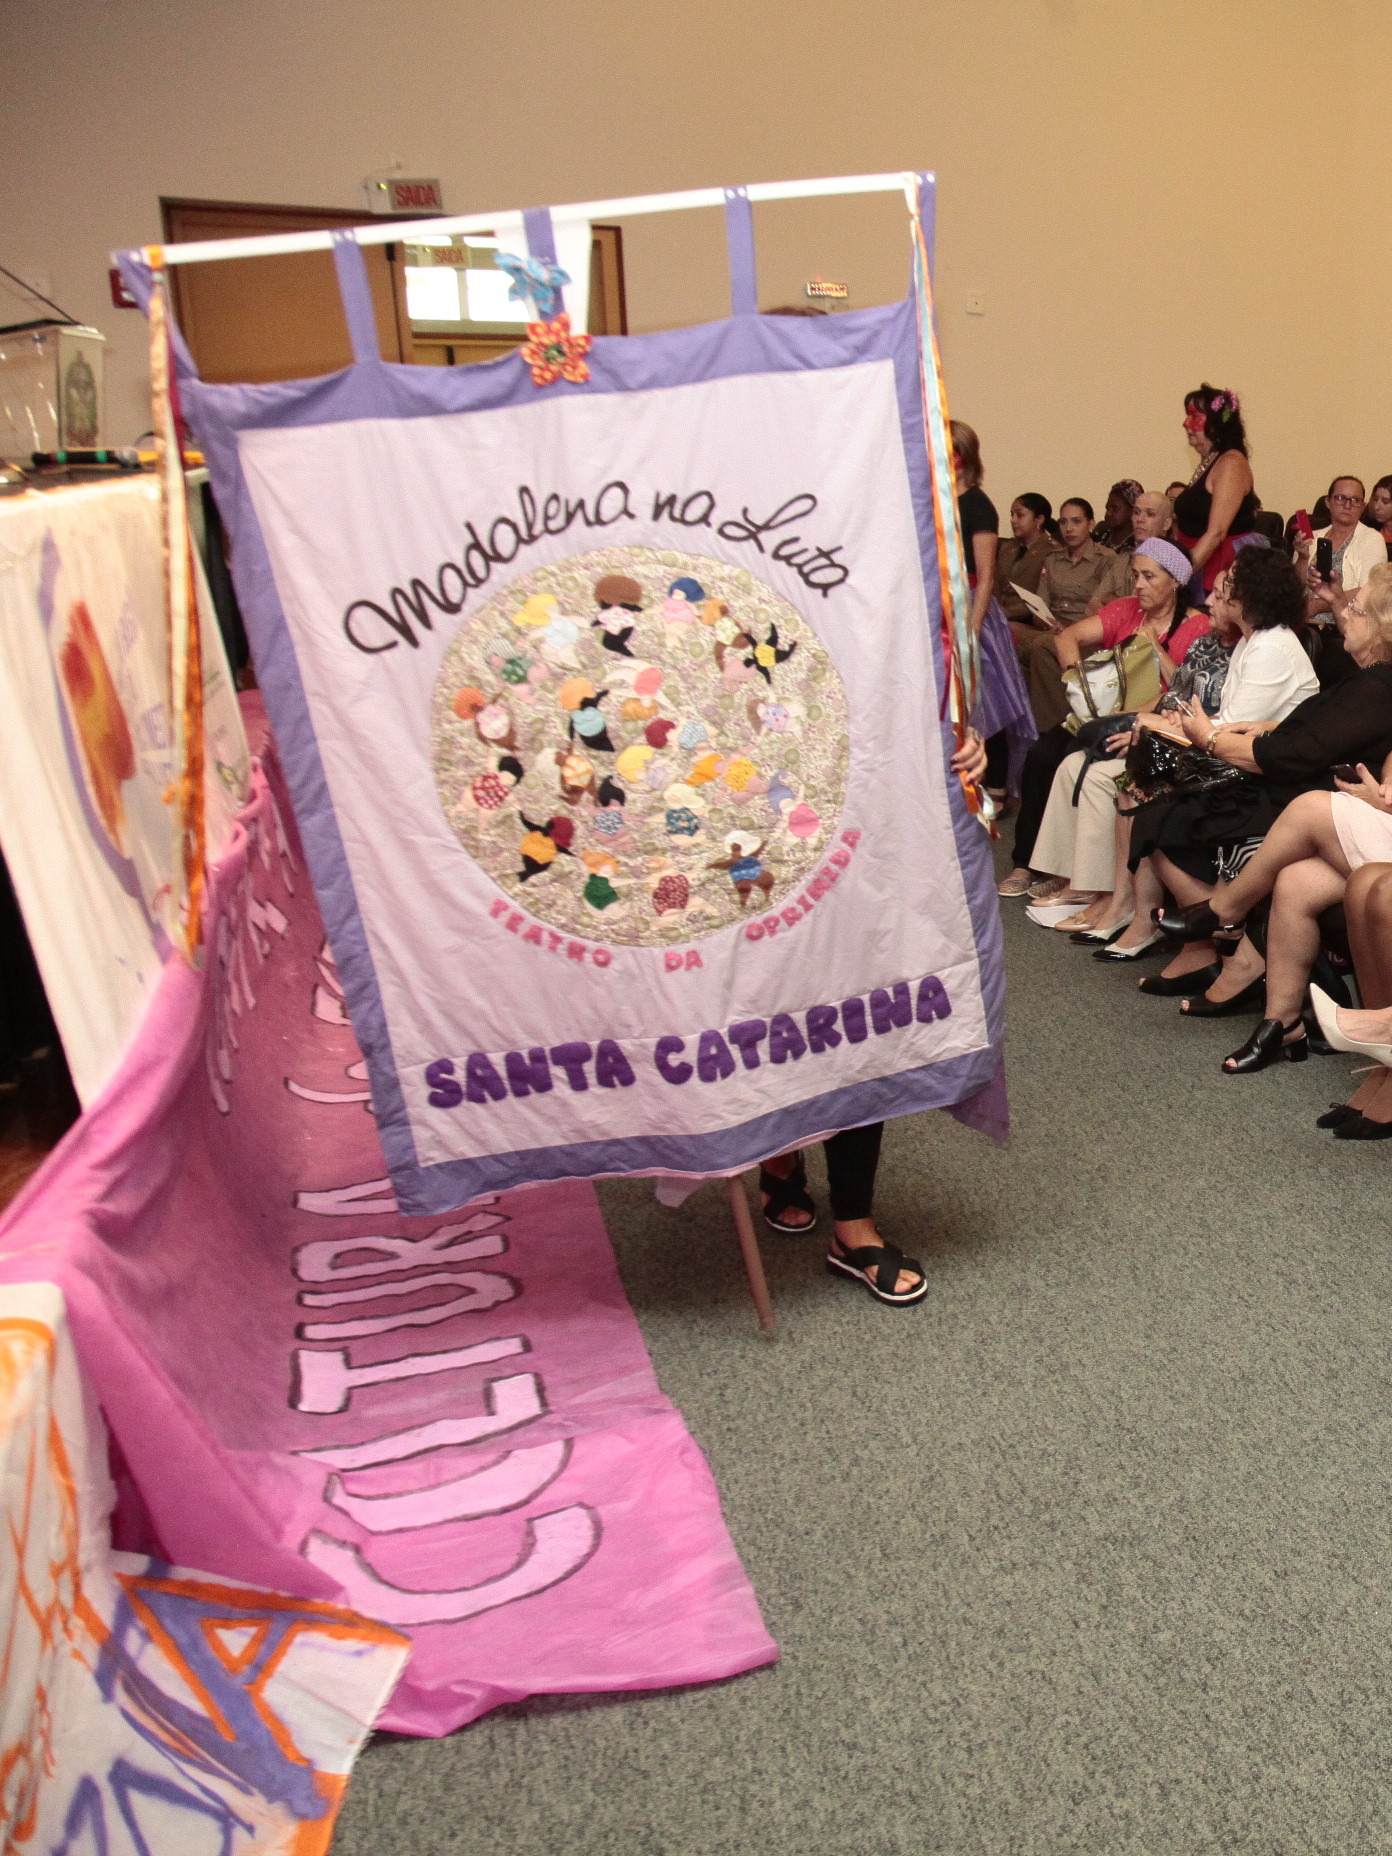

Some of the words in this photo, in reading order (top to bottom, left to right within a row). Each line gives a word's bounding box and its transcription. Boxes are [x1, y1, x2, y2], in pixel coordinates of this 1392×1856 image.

[343, 480, 636, 656] Madalena
[651, 489, 716, 527] na
[717, 492, 849, 599] Luta
[489, 899, 613, 969] TEATRO
[664, 949, 704, 973] DA
[745, 829, 862, 941] OPRIMIDA
[425, 1038, 637, 1109] SANTA
[653, 974, 953, 1085] CATARINA
